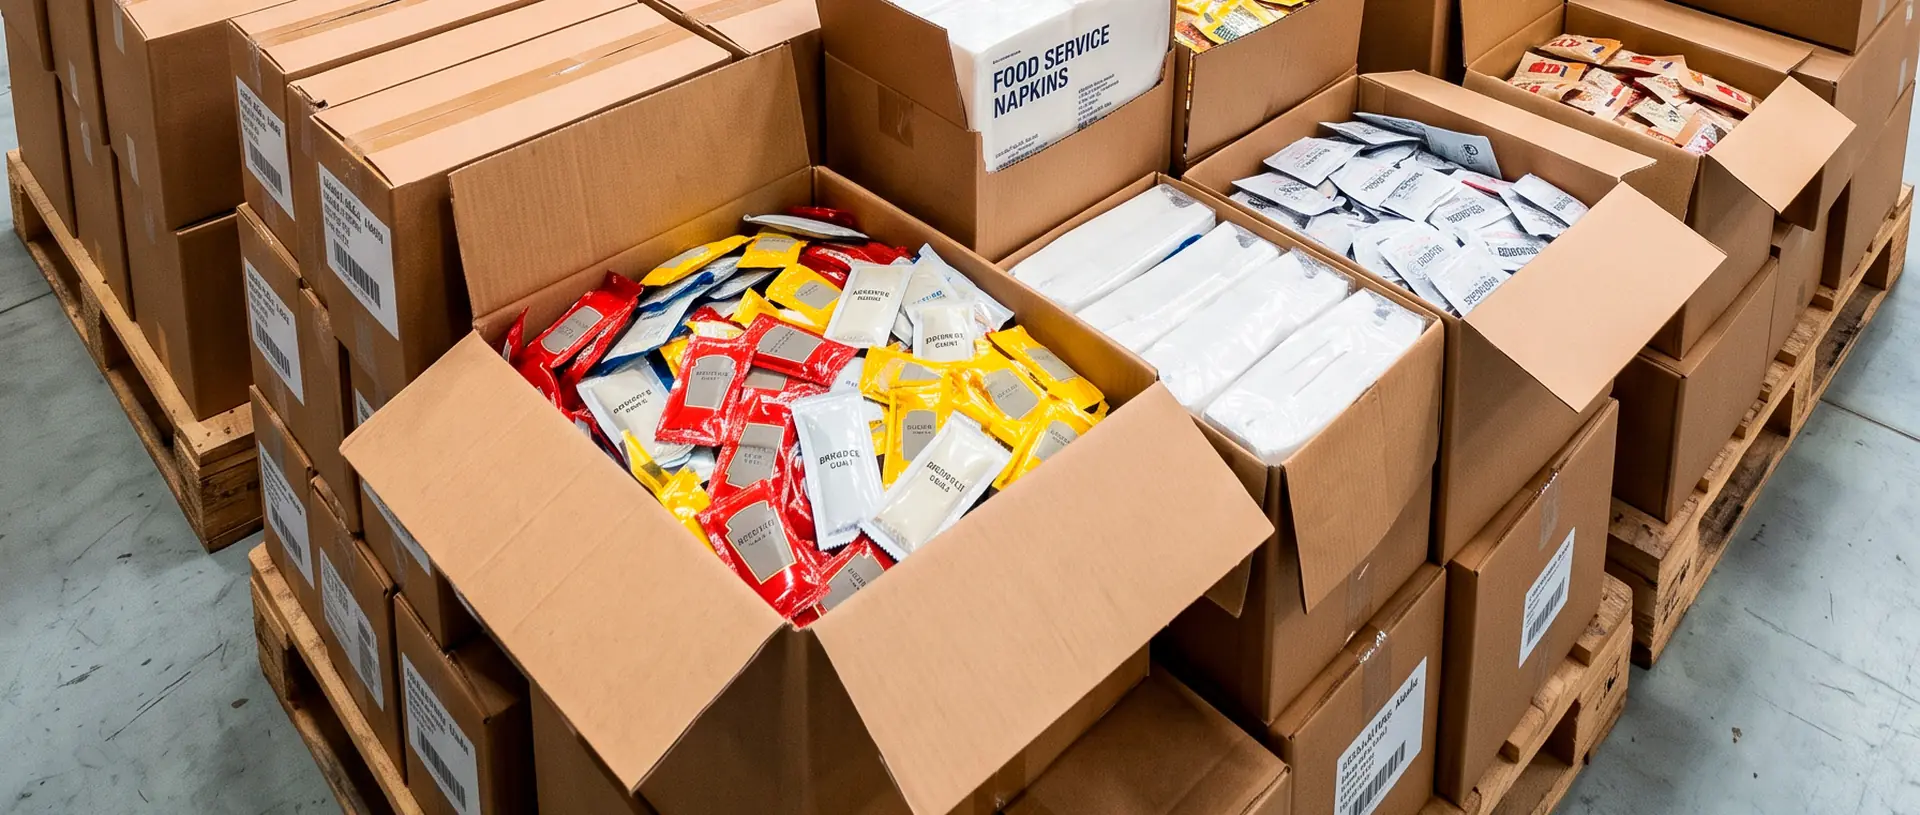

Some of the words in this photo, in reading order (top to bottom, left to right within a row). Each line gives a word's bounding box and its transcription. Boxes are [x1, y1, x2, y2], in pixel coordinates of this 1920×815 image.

[993, 56, 1039, 93] FOOD
[1044, 24, 1110, 70] SERVICE
[994, 67, 1069, 118] NAPKINS
